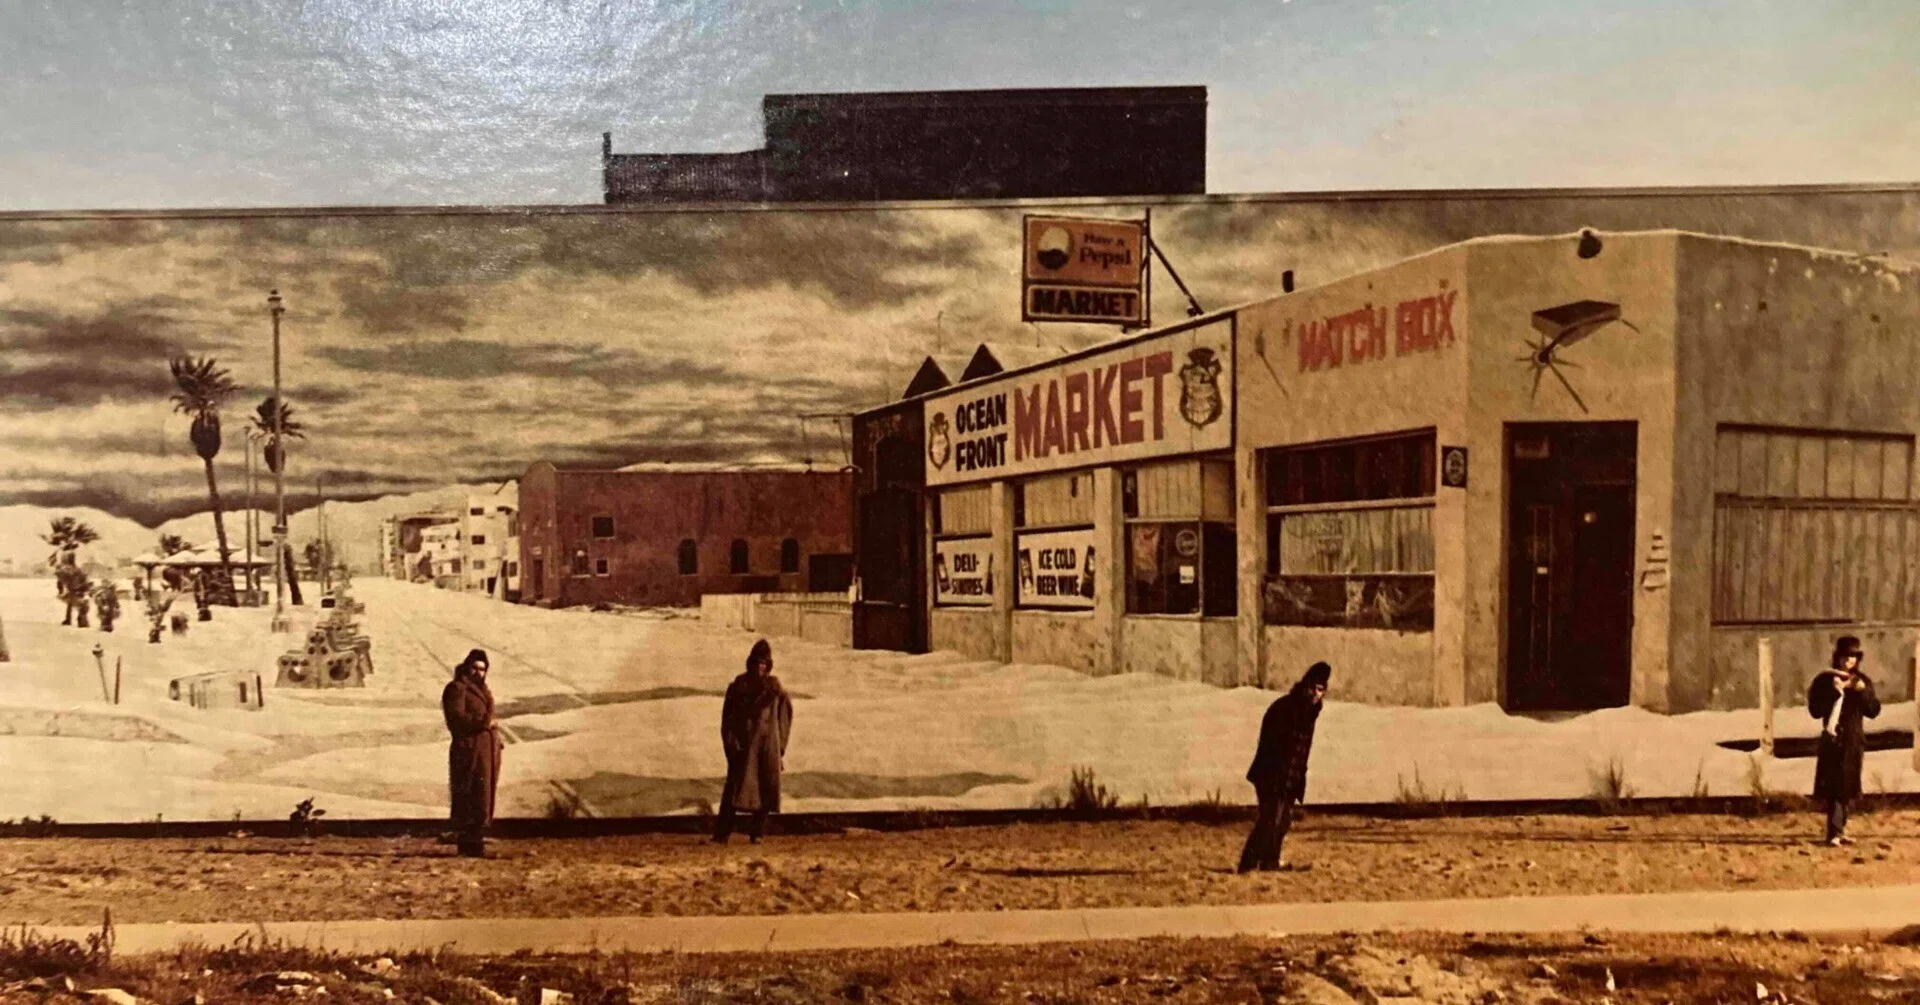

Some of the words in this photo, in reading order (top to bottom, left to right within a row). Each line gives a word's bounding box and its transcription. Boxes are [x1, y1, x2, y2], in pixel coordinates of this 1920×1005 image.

[1079, 247, 1131, 269] Pepsi
[1032, 289, 1138, 315] MARKET
[1298, 305, 1387, 373] MATCH
[1395, 290, 1457, 358] BOX
[956, 393, 1007, 434] OCEAN
[1014, 351, 1173, 461] MARKET
[956, 433, 1008, 472] FRONT
[1038, 549, 1052, 569] ICE
[1054, 548, 1076, 569] COLD
[1037, 576, 1057, 596] BEER
[1058, 575, 1080, 596] WINE
